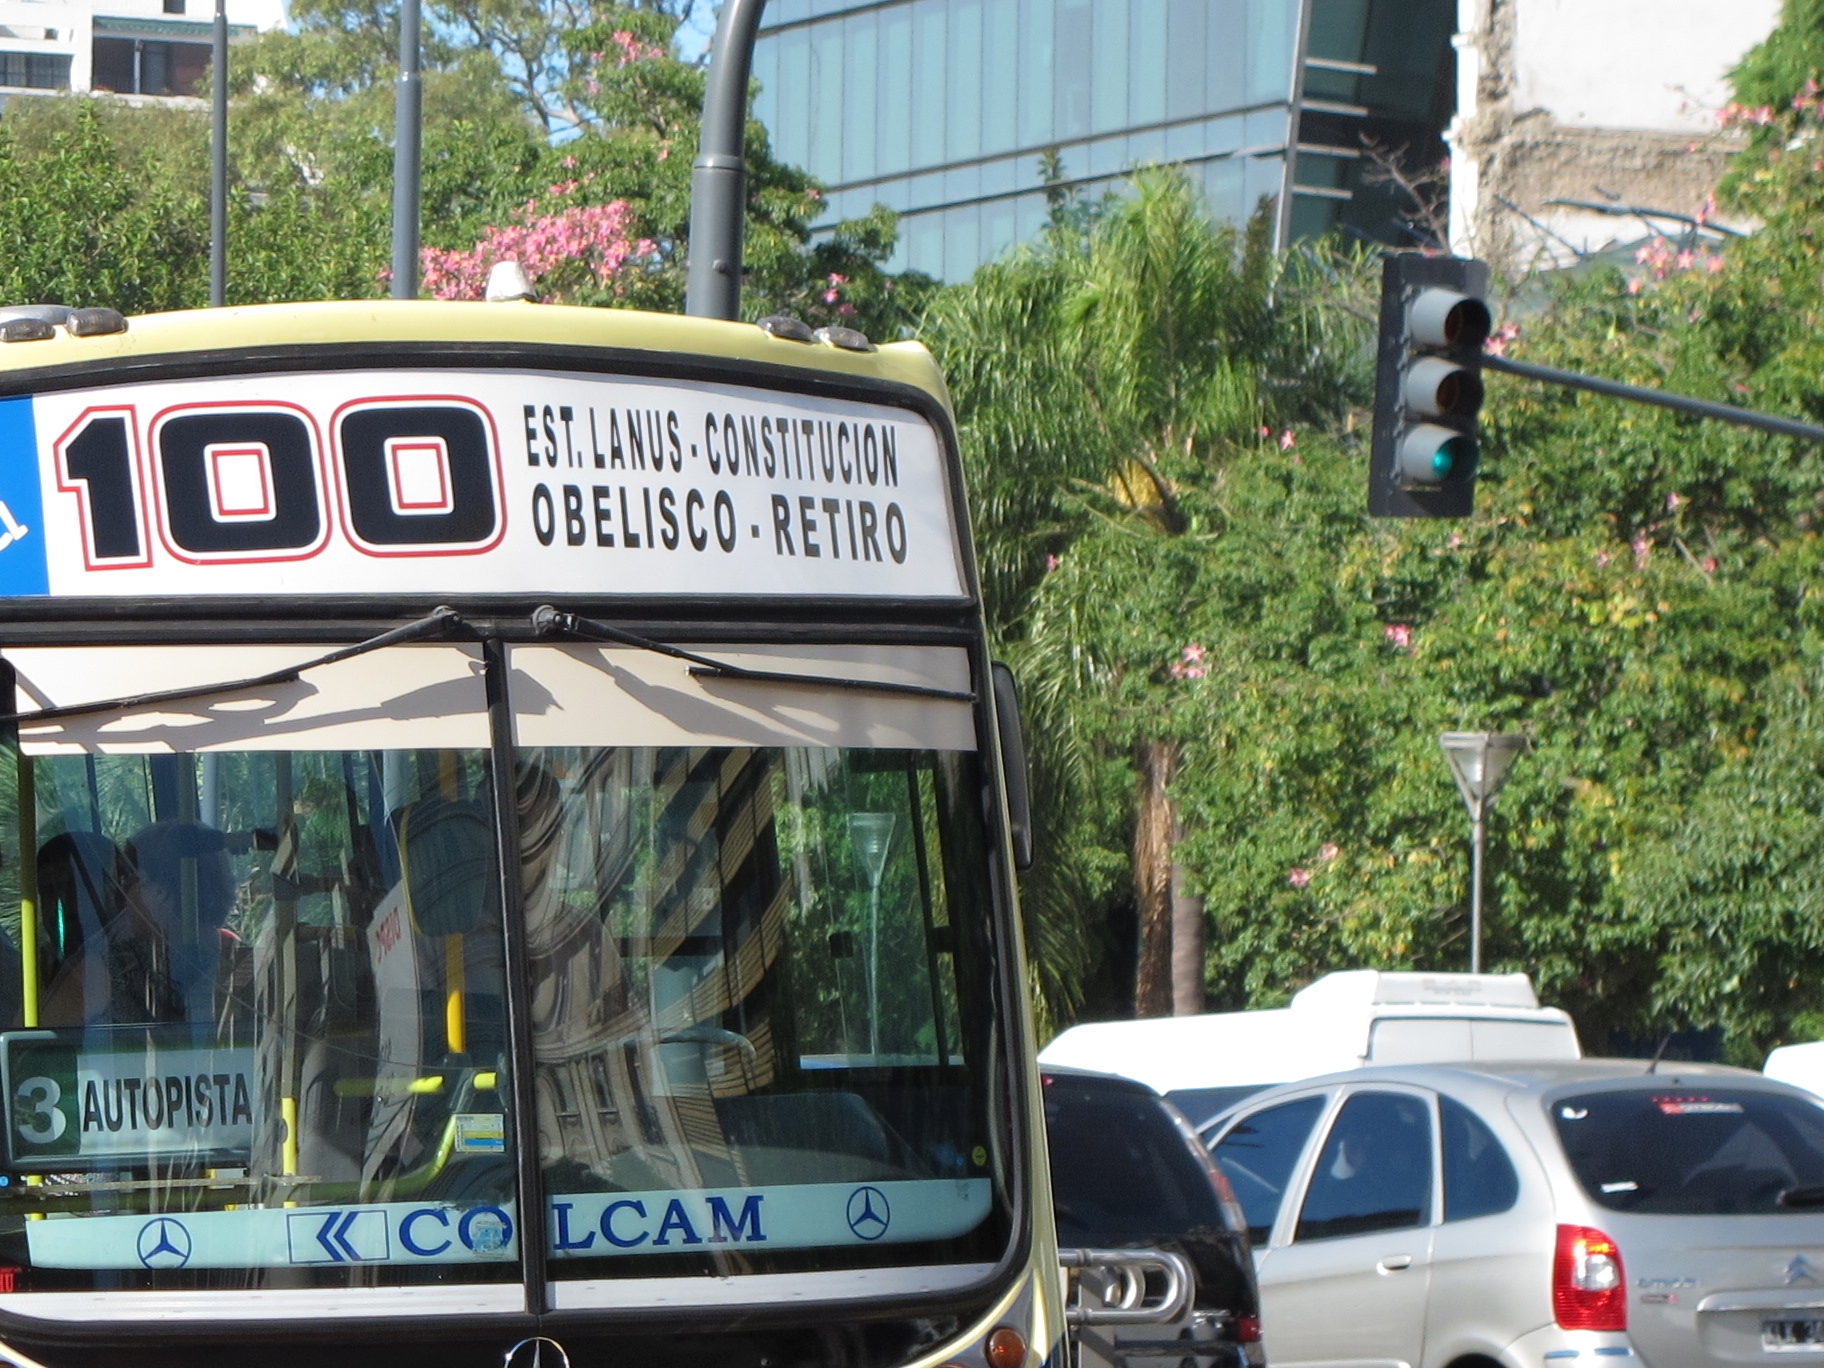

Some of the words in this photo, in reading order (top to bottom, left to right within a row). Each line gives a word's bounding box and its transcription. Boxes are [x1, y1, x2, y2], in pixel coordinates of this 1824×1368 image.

[53, 395, 507, 572] 100
[523, 404, 583, 468] EST.
[590, 407, 682, 473] LANUS
[704, 411, 900, 487] CONSTITUCION
[533, 483, 737, 553] OBELISCO
[771, 494, 907, 565] RETIRO
[16, 1076, 67, 1144] 3
[83, 1072, 253, 1133] AUTOPISTA
